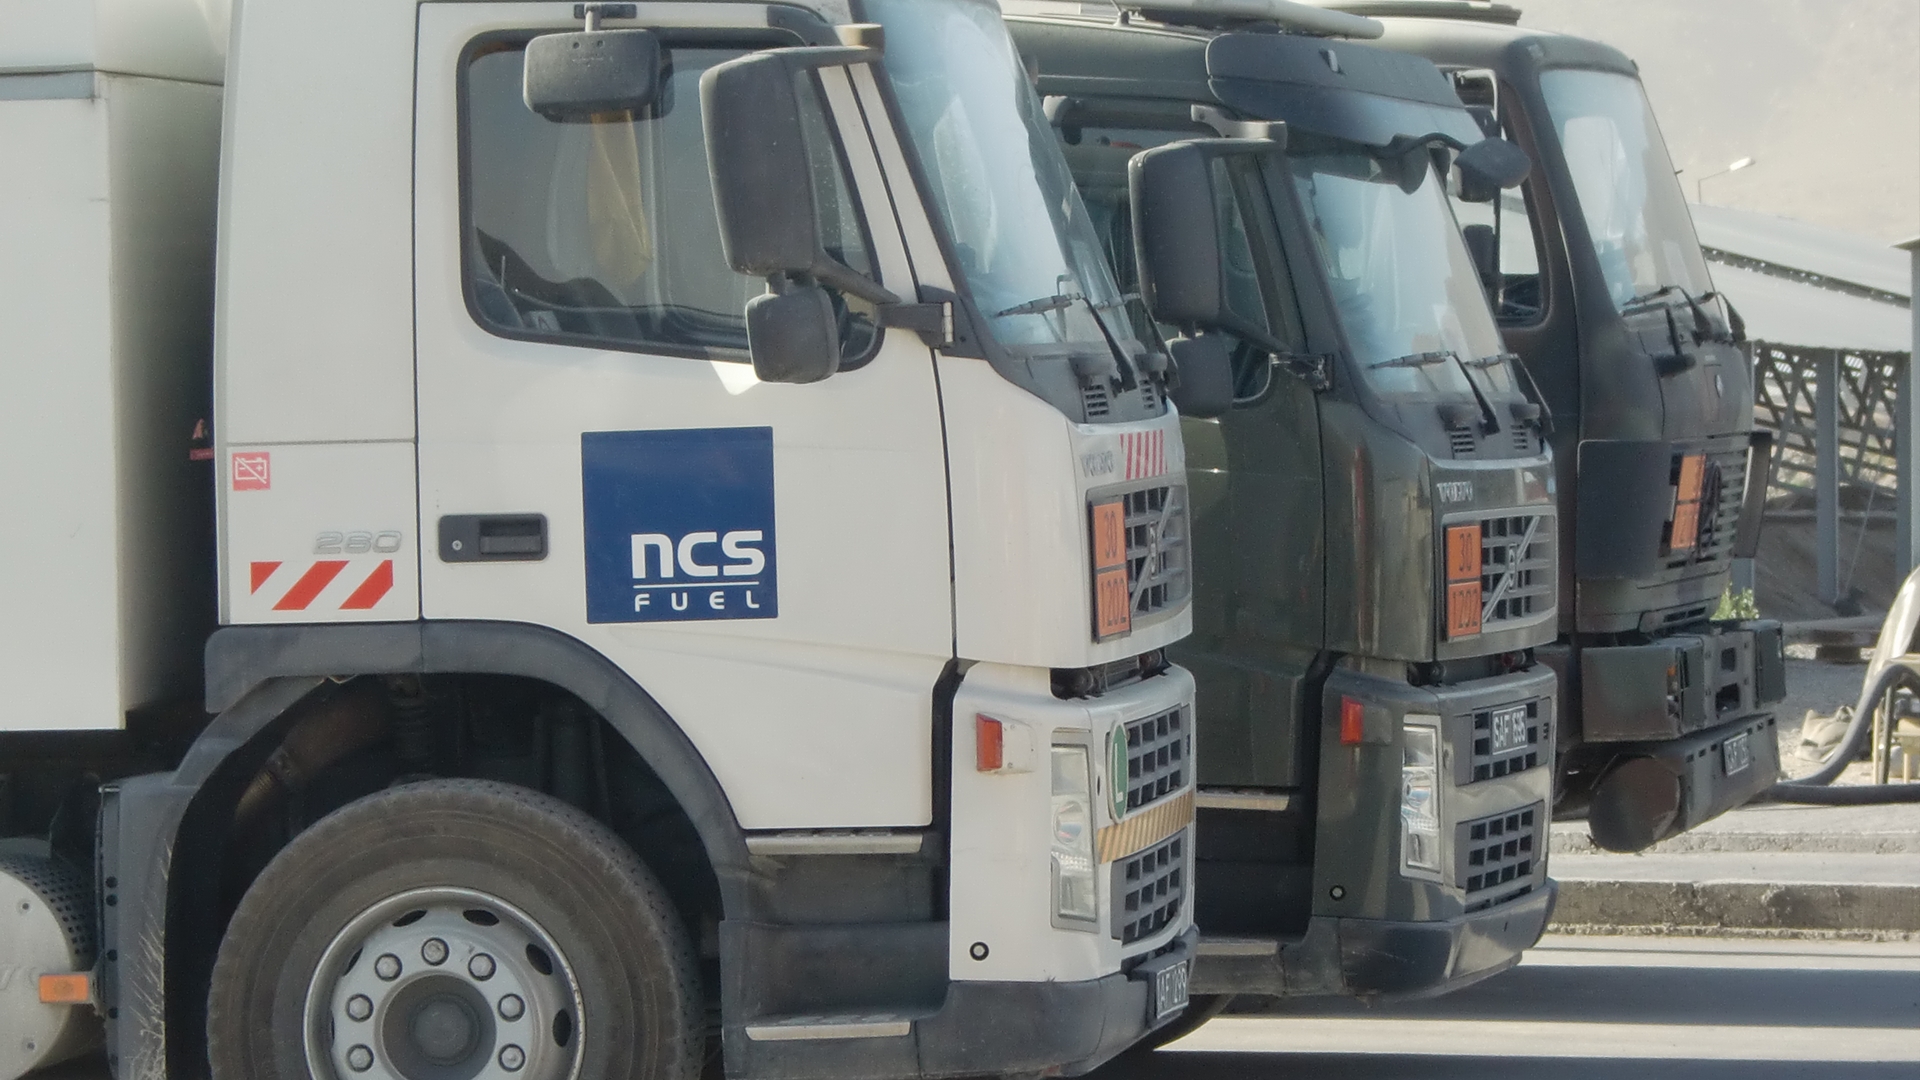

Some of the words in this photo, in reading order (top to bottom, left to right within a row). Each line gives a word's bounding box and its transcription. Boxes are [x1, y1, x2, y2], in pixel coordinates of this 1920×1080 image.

[1458, 532, 1474, 572] 30
[633, 590, 761, 613] FUEL
[1114, 742, 1124, 803] L
